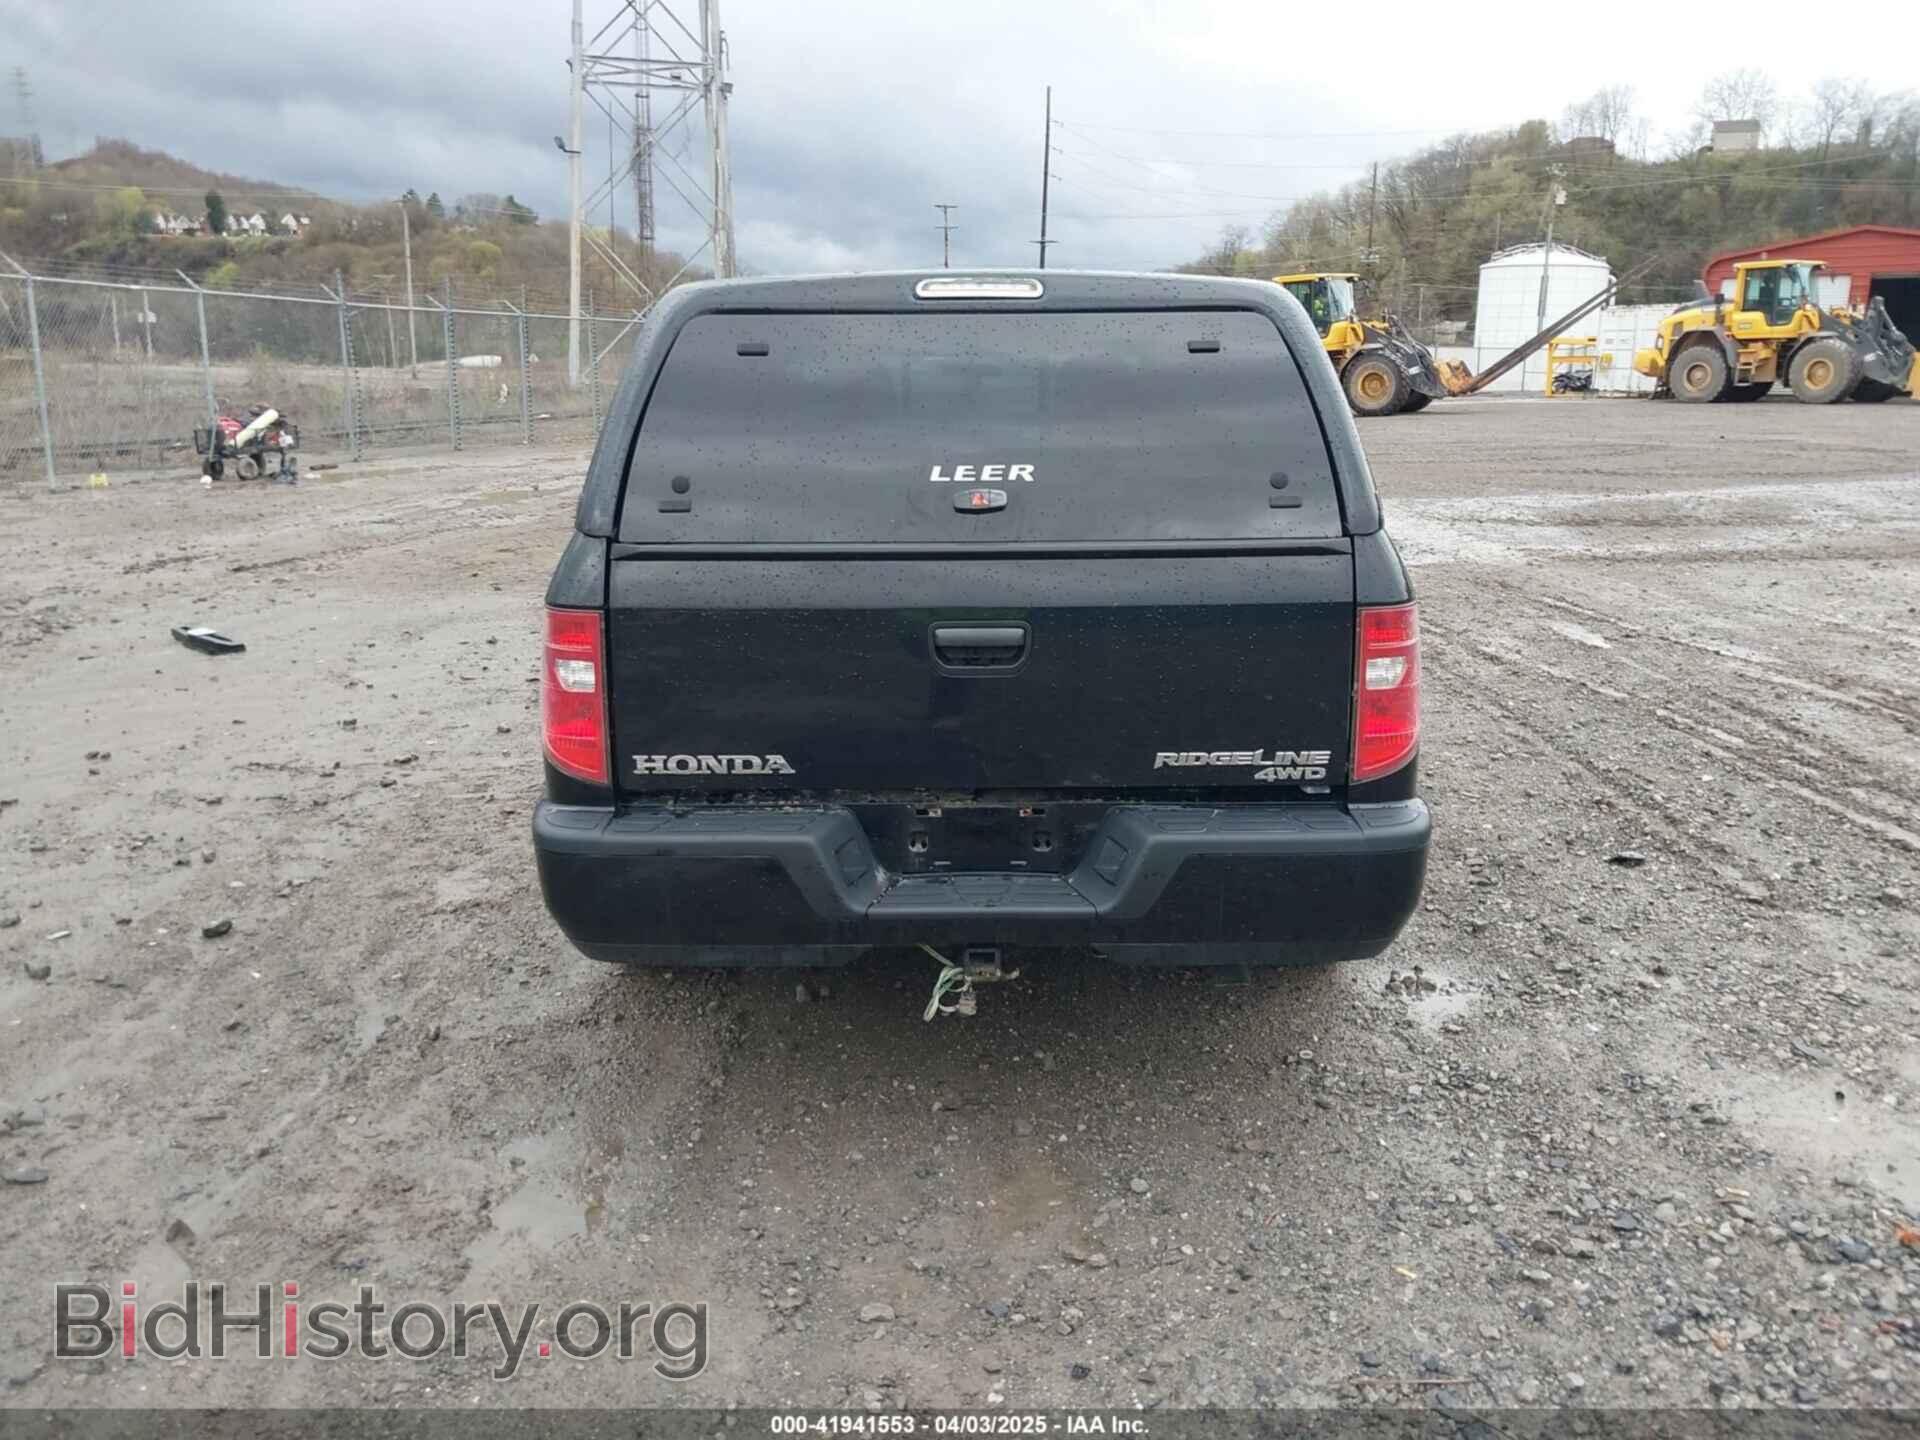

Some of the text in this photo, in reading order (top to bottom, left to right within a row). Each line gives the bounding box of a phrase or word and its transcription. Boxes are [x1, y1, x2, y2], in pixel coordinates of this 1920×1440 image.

[929, 464, 1035, 482] LEER
[632, 754, 796, 774] HONDA
[1153, 748, 1332, 770] RIDGELINE
[1253, 766, 1328, 783] 4WD
